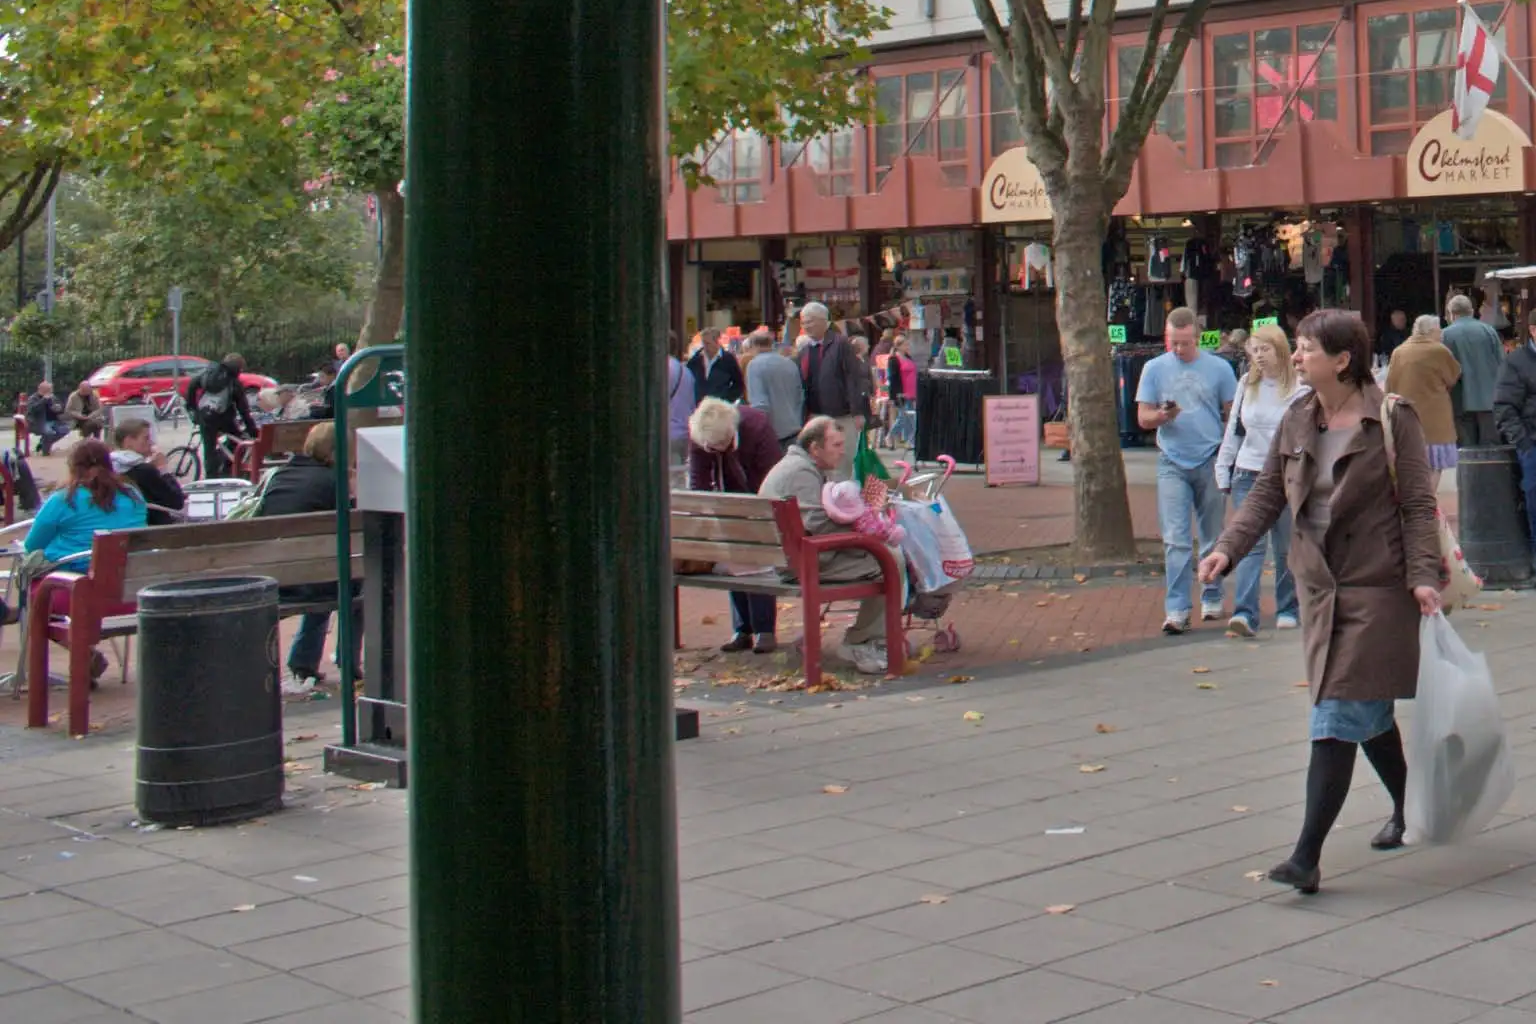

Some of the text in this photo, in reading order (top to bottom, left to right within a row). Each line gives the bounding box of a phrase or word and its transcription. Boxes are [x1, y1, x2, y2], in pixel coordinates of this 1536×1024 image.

[1419, 139, 1510, 182] Chelmsford
[1444, 167, 1511, 183] MARKET
[990, 173, 1044, 210] Chelmsfo
